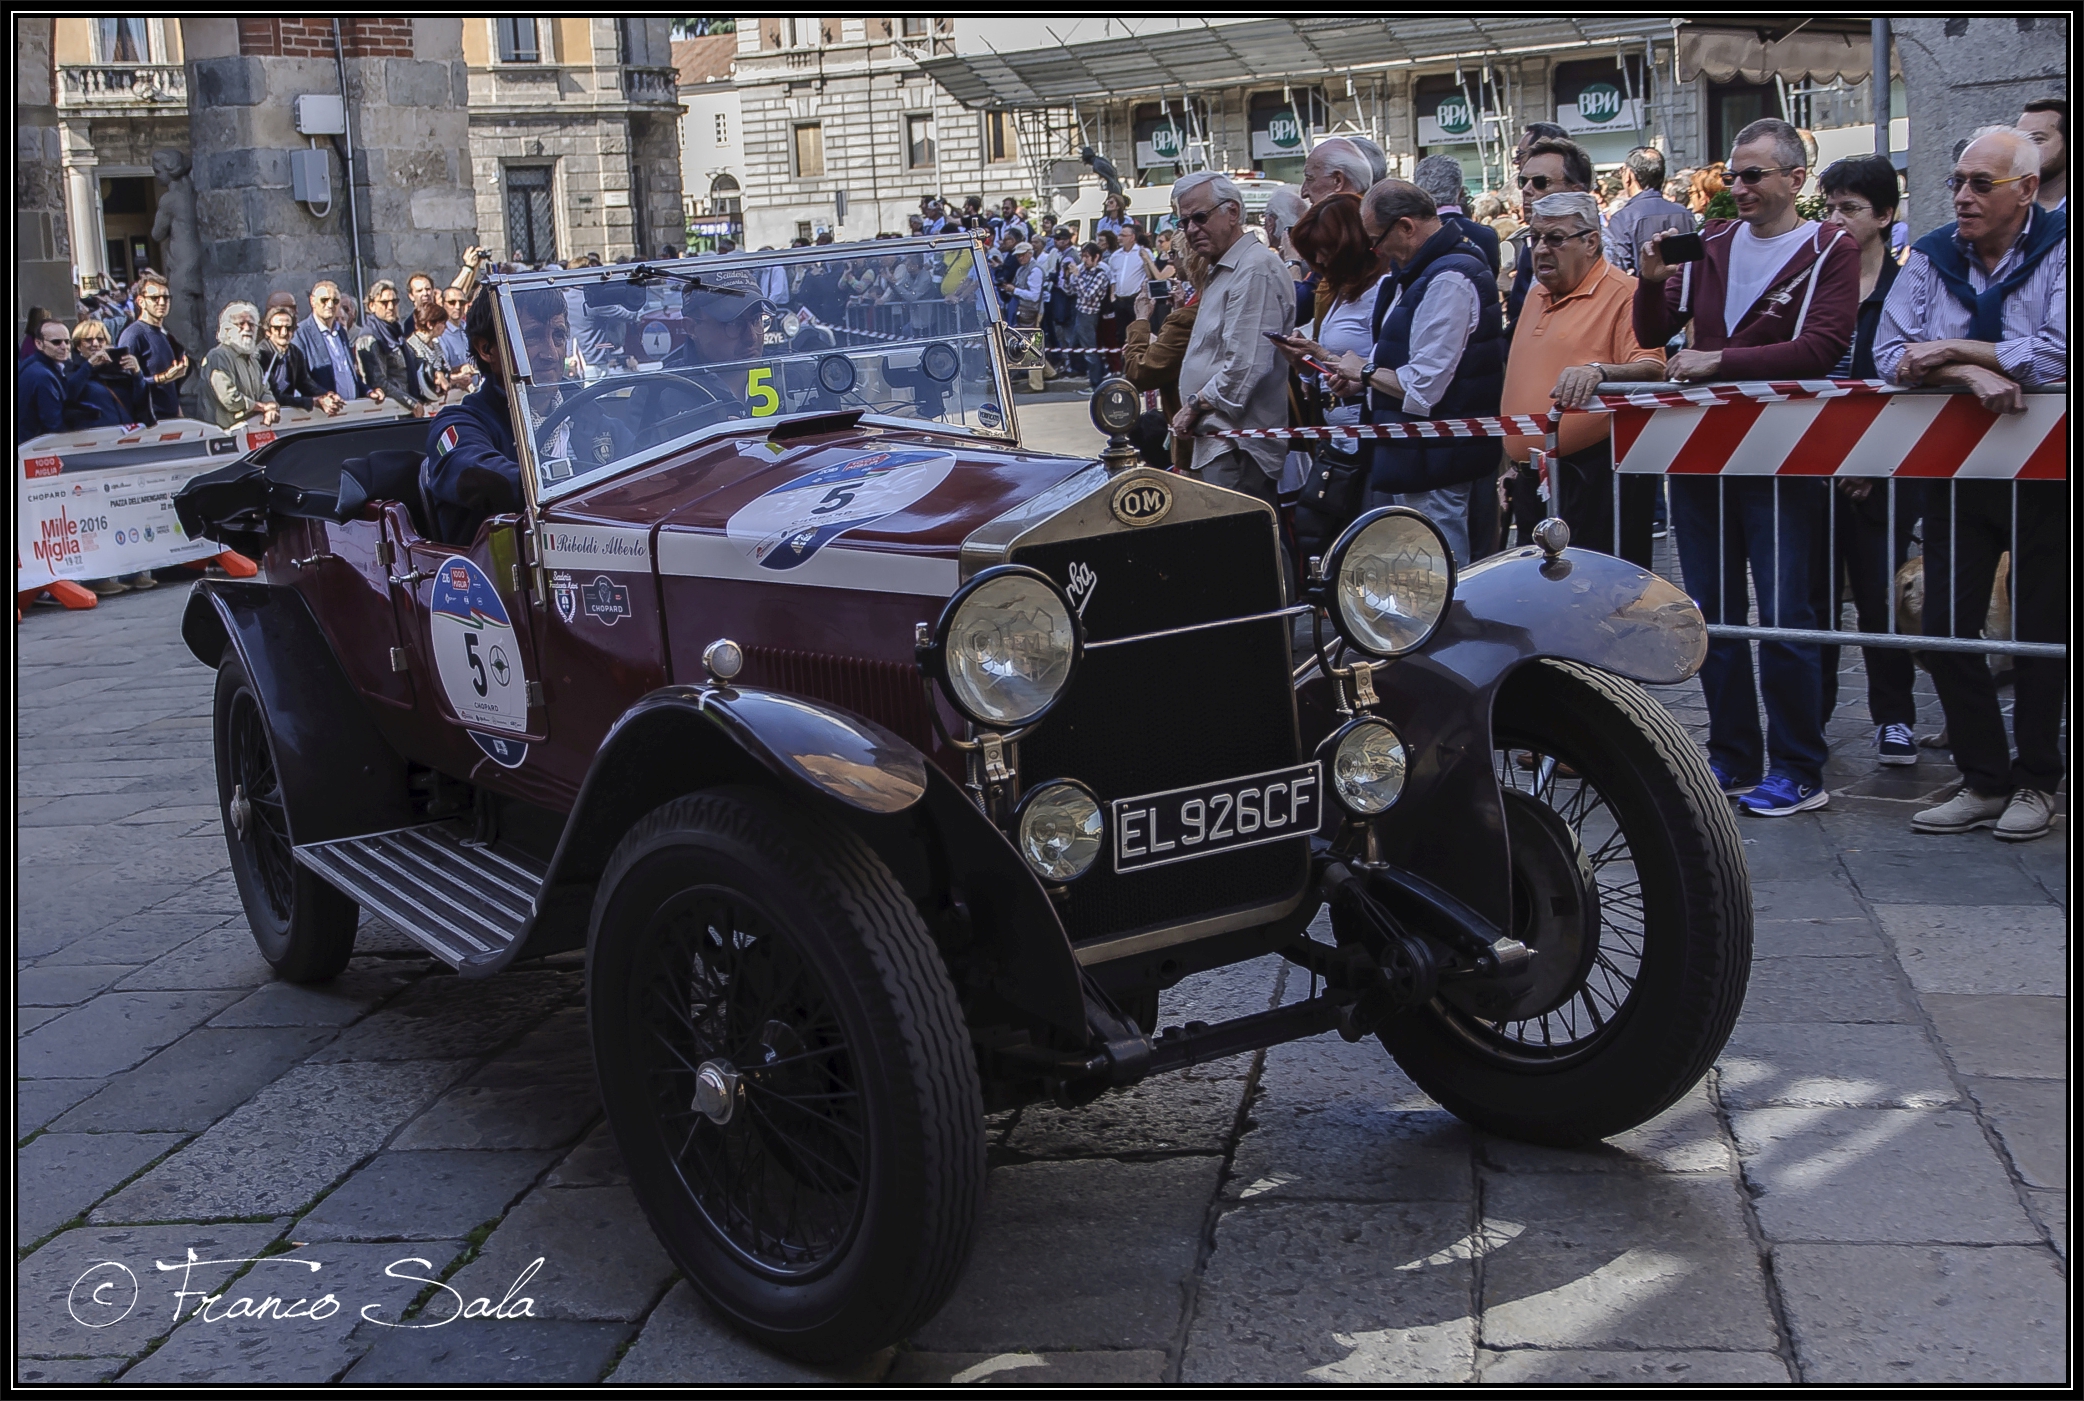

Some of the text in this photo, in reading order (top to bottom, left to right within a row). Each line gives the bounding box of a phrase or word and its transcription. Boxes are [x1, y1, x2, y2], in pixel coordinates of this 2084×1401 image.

[1578, 90, 1620, 116] BPM
[1437, 104, 1474, 127] BPM
[1152, 130, 1184, 151] BPM
[1269, 119, 1303, 141] BPM
[653, 335, 660, 348] 4
[763, 332, 784, 345] 92YE
[748, 367, 779, 418] 5
[34, 458, 55, 467] 1000
[34, 467, 57, 477] MIGLIA
[27, 490, 67, 502] CHOPARD
[110, 498, 128, 508] PIAZZA
[811, 482, 866, 515] 5
[1124, 489, 1161, 515] OM
[41, 504, 108, 539] Mille 2016
[556, 533, 647, 557] Riboldi Alberto
[33, 537, 81, 576] Miglia
[452, 570, 465, 579] 1000
[453, 580, 468, 588] MIGLIA
[591, 604, 624, 614] CHOPARD
[464, 632, 488, 698] 5
[474, 702, 499, 712] CHOPARD
